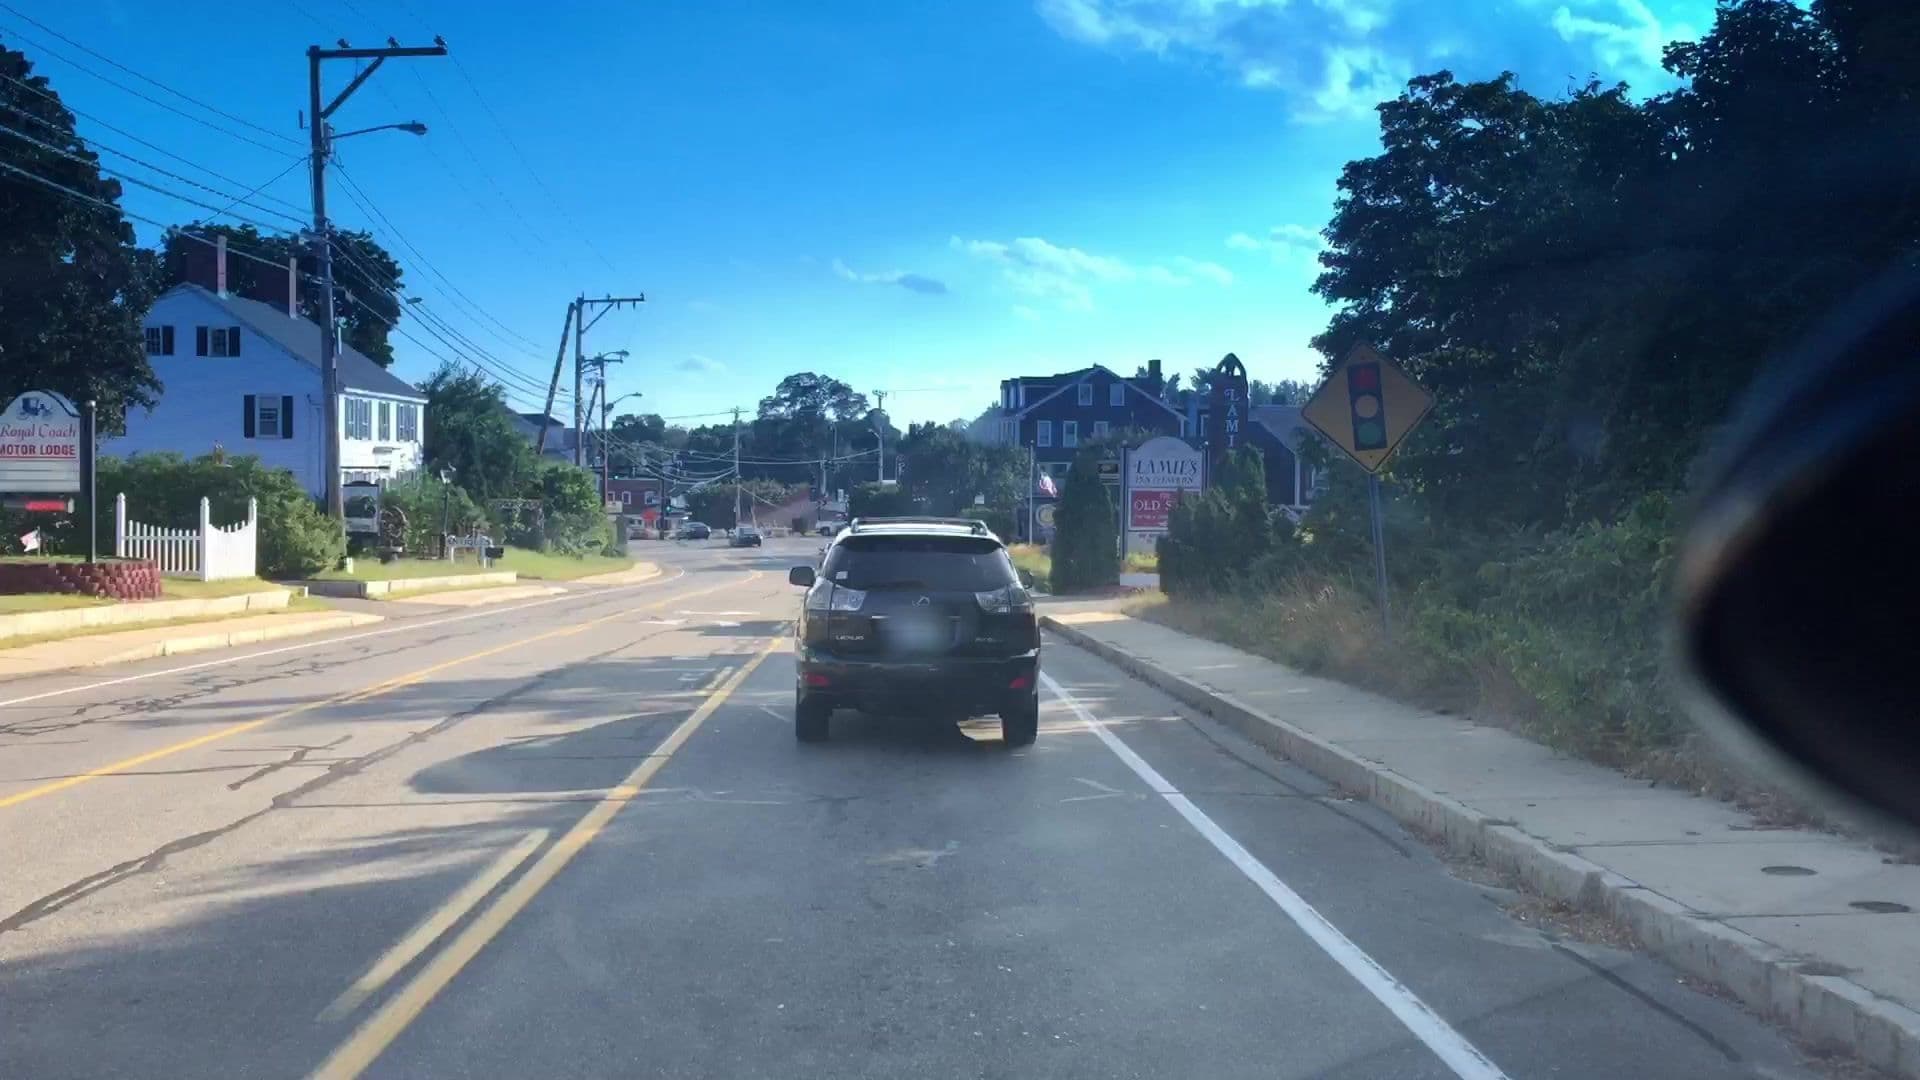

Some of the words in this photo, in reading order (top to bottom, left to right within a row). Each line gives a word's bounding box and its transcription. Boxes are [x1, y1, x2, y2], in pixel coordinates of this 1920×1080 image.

[1224, 388, 1241, 448] LAMI
[0, 423, 36, 440] Royal
[39, 423, 76, 438] Coach
[0, 444, 36, 456] MOTOR
[40, 444, 76, 456] LODGE
[1134, 500, 1161, 511] OLD
